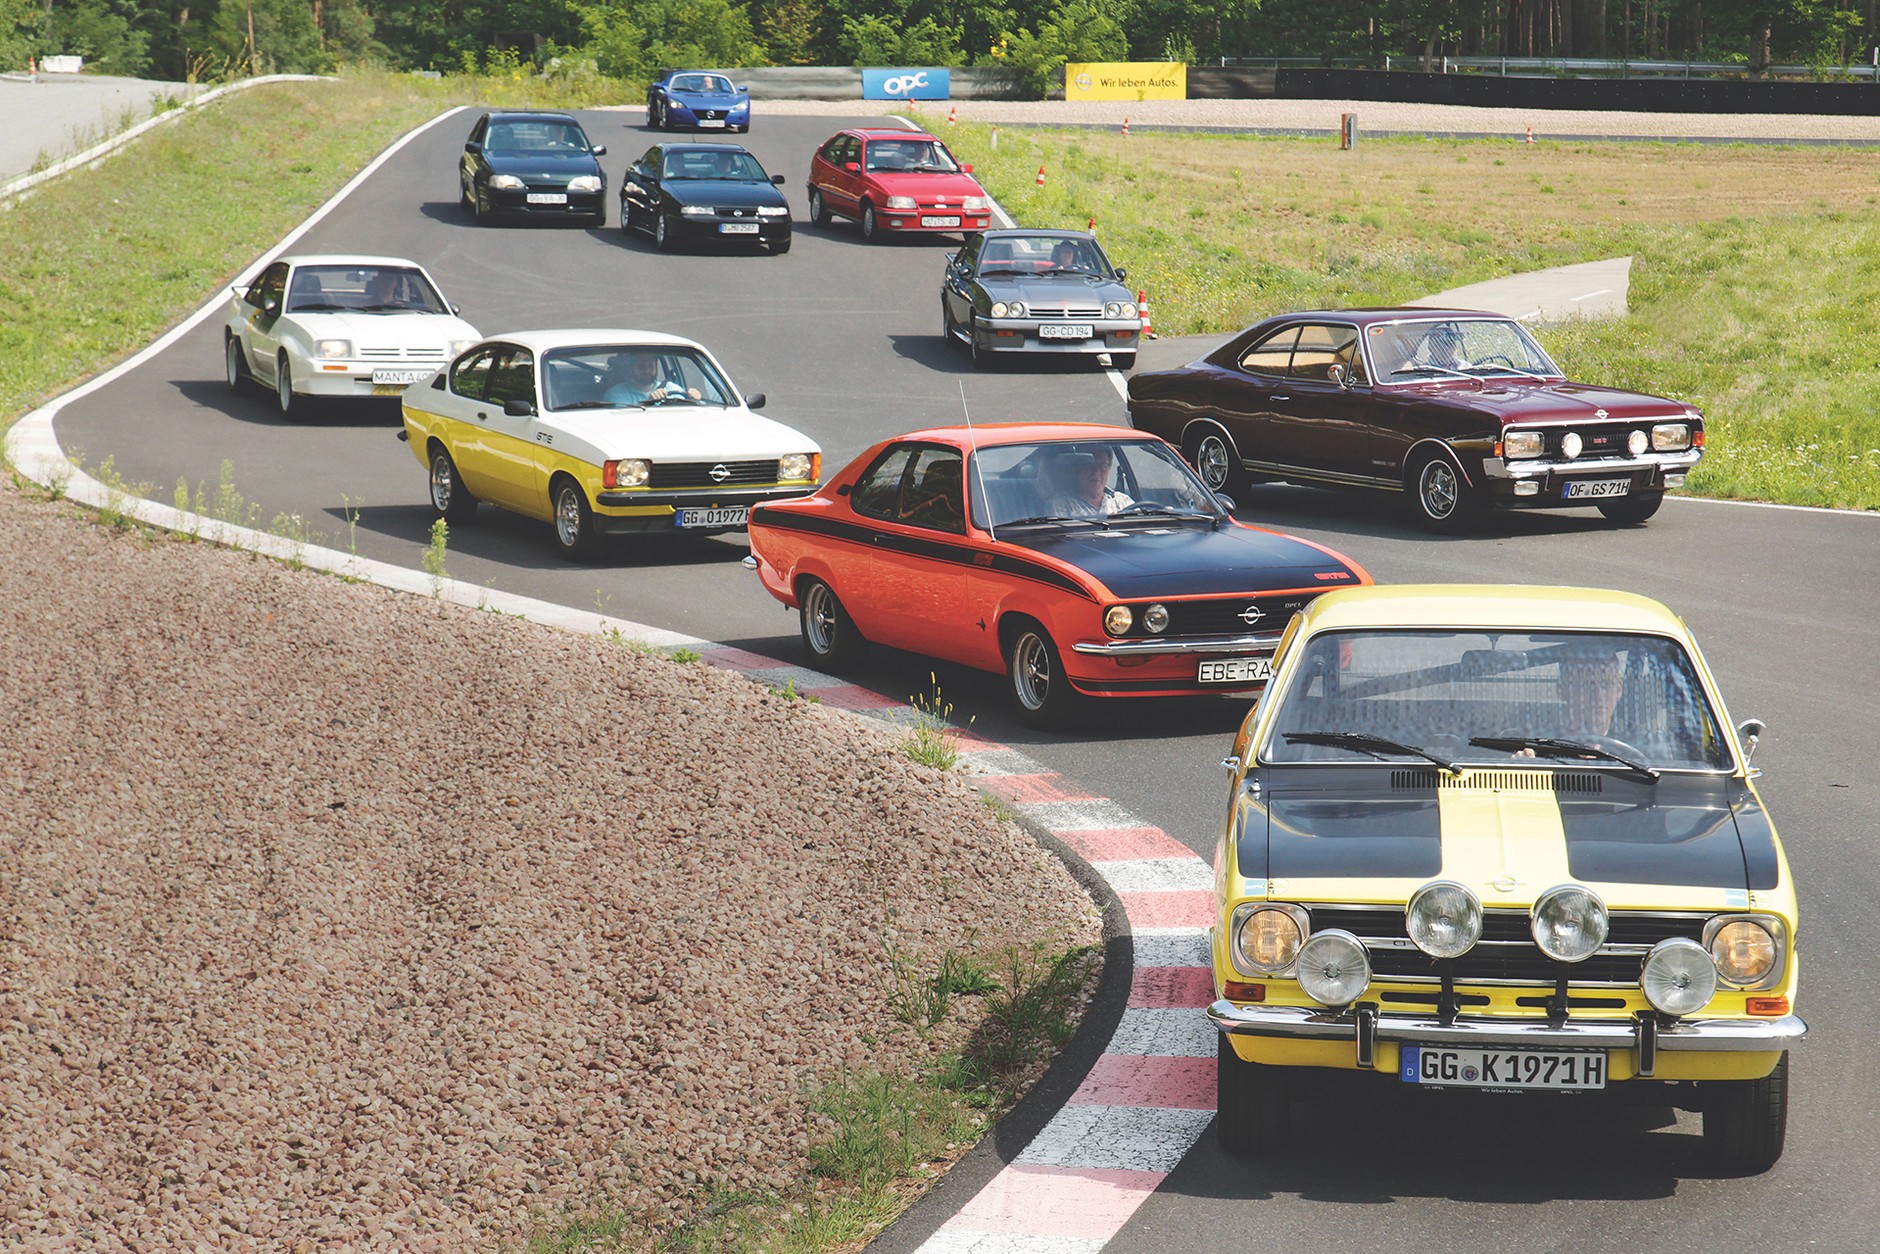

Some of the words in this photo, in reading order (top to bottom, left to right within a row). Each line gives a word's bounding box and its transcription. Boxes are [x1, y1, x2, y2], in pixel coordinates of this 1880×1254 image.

[1100, 78, 1116, 87] Wir
[1119, 78, 1146, 87] leben
[1148, 78, 1179, 87] Autos.
[1570, 484, 1586, 497] OF
[1591, 483, 1607, 496] GS
[683, 511, 698, 524] GG
[1421, 1052, 1459, 1080] GG
